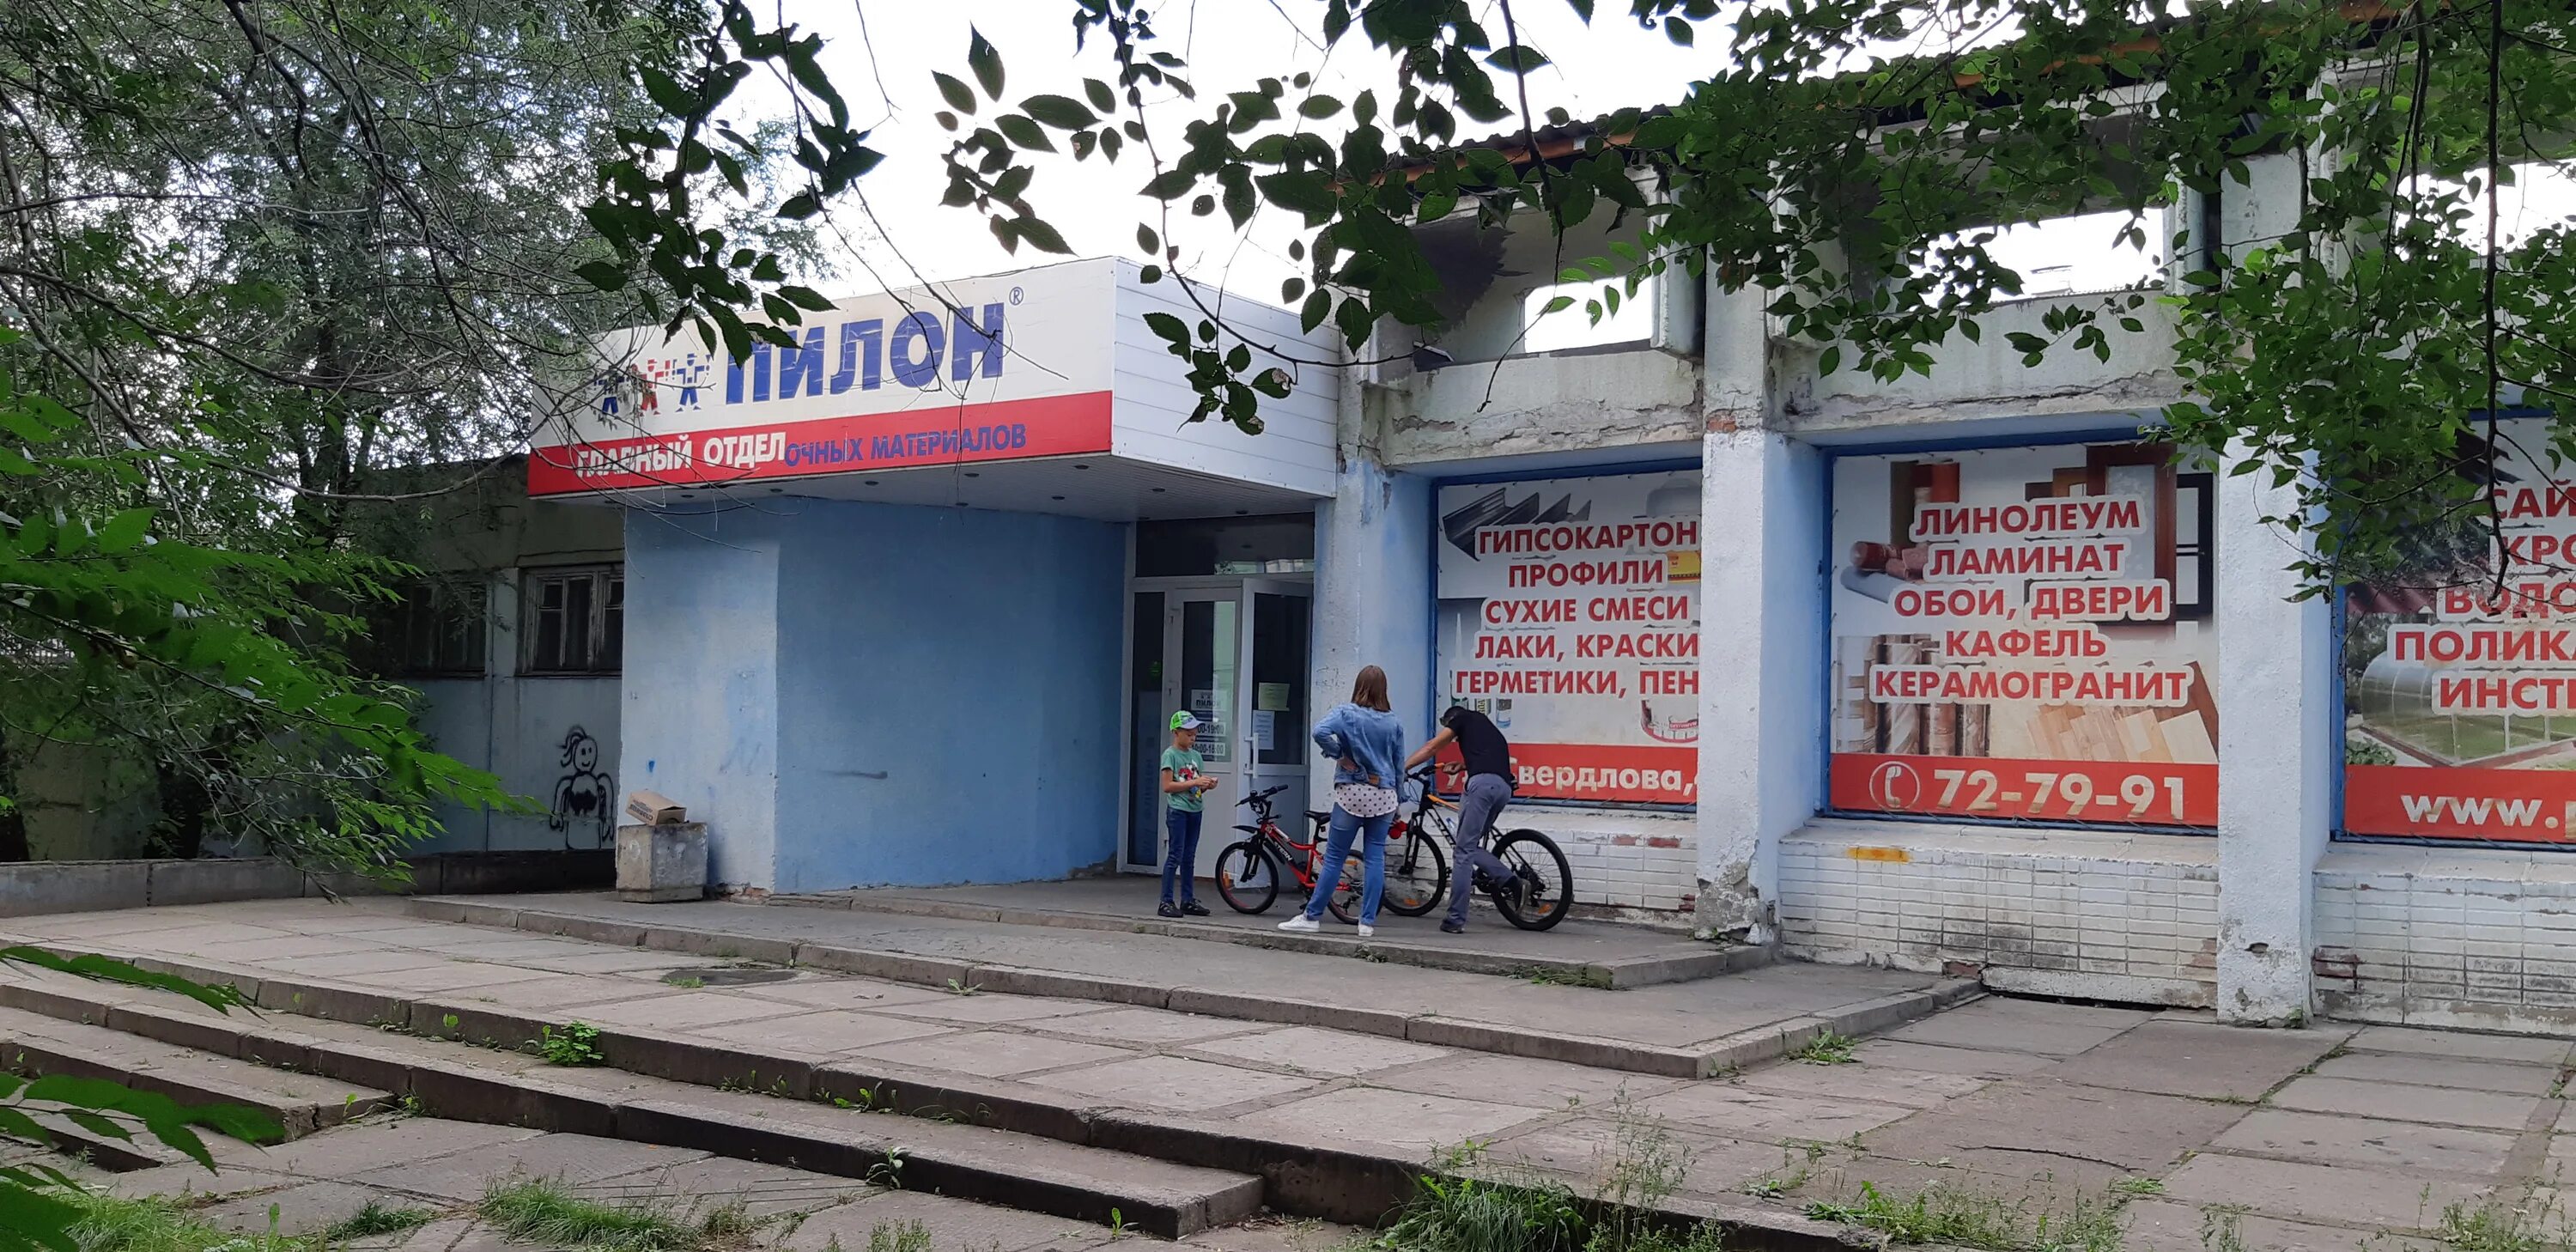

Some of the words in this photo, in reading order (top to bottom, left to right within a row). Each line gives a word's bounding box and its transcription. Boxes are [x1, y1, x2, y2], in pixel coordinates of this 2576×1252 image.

[726, 302, 1004, 404] ПИЛОН
[577, 434, 692, 477] ГЛАВНЫЙ
[703, 432, 787, 468] ОТДЕЛ
[871, 424, 1026, 459] МАТЕРИАЛОВ
[1915, 501, 2140, 536] ЛИНОЛЕУМ
[1479, 521, 1697, 554] ГИПСОКАРТОН
[1509, 560, 1663, 588] ПРОФИЛИ
[1929, 544, 2124, 575] ЛАМИНАТ
[1485, 599, 1577, 623] СУХИЕ
[1588, 596, 1688, 622] СМЕСИ
[1894, 589, 2017, 621] ОБОИ,
[2031, 586, 2163, 620] ДВЕРИ
[1475, 635, 1564, 662] ЛАКИ,
[1577, 633, 1698, 658] КРАСКИ
[1946, 629, 2106, 657] КАФЕЛЬ
[2395, 631, 2576, 661] ПОЛИК
[1456, 671, 1626, 697] ГЕРМЕТИКИ,
[1639, 670, 1698, 694] ПЕН
[1875, 672, 2186, 700] КЕРАМОГРАНИТ
[1934, 769, 2184, 820] 72-79-91
[2401, 795, 2576, 839] www.
